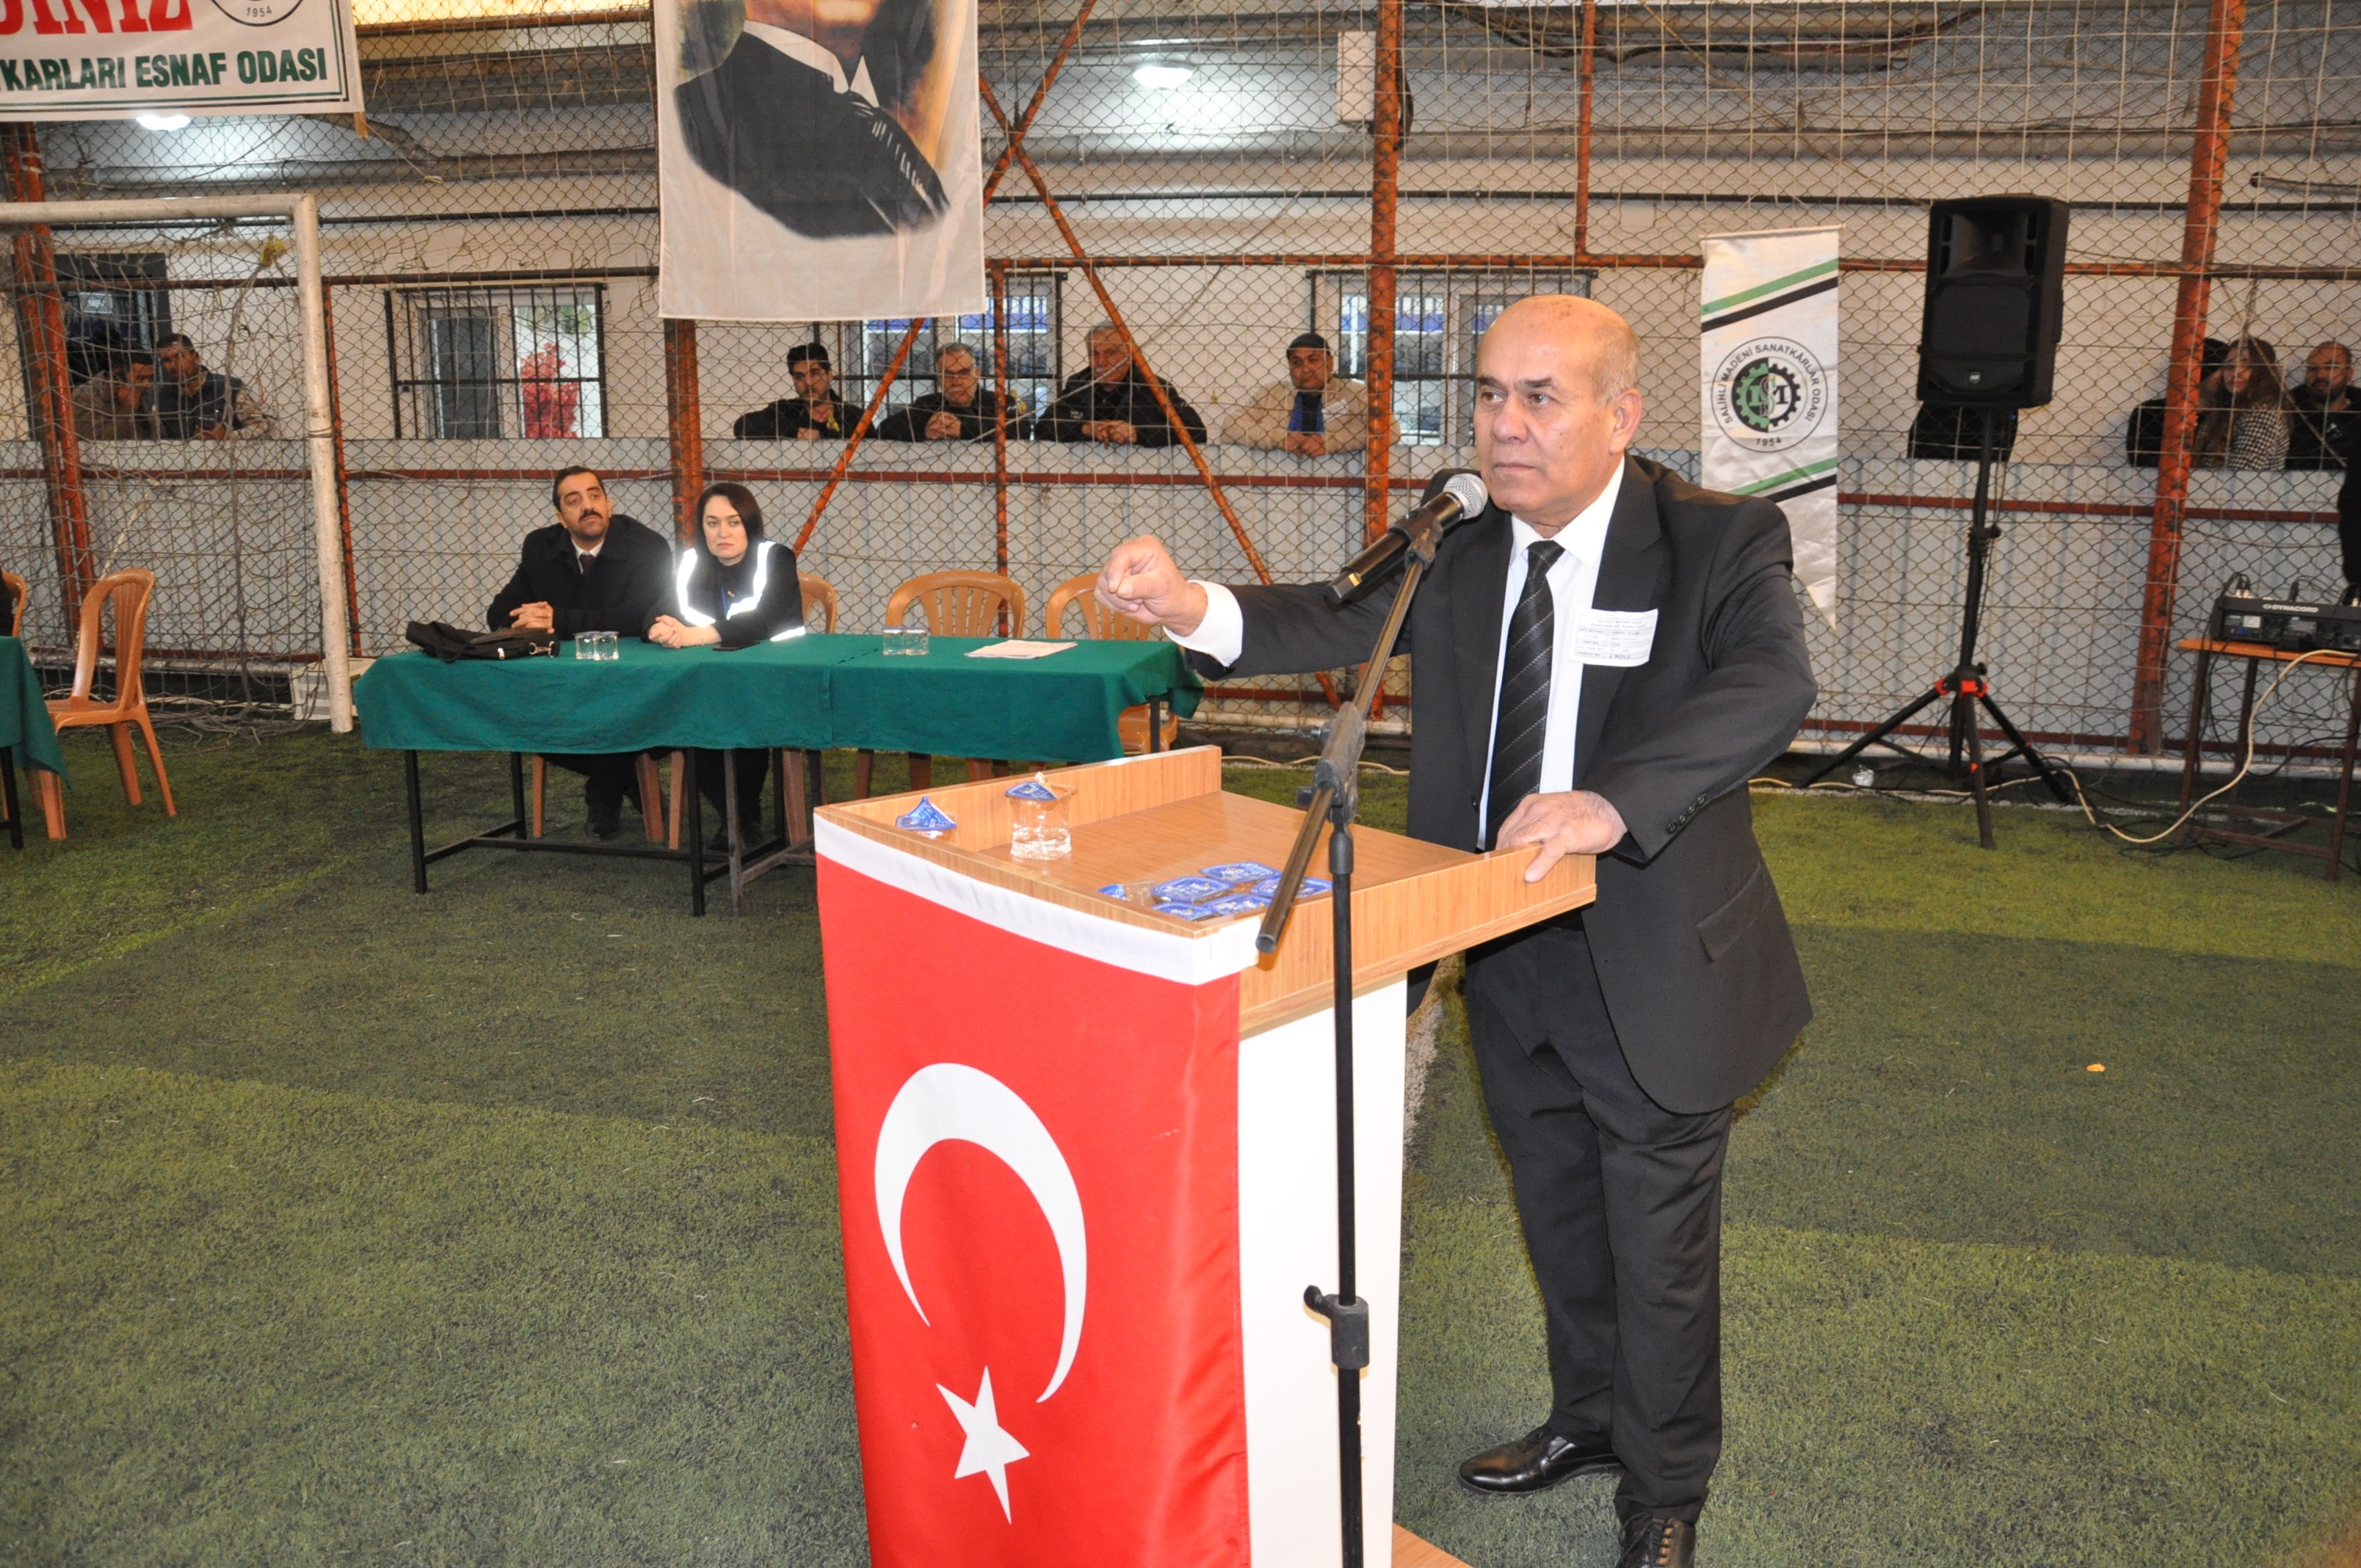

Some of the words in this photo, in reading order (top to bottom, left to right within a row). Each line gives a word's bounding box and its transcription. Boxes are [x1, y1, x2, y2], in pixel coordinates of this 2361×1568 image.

[246, 5, 272, 18] 1954
[0, 57, 126, 91] KARLARI
[135, 52, 228, 87] ESNAF
[236, 48, 328, 84] ODASI
[1805, 388, 1821, 422] ODASI
[1755, 438, 1782, 446] 1954
